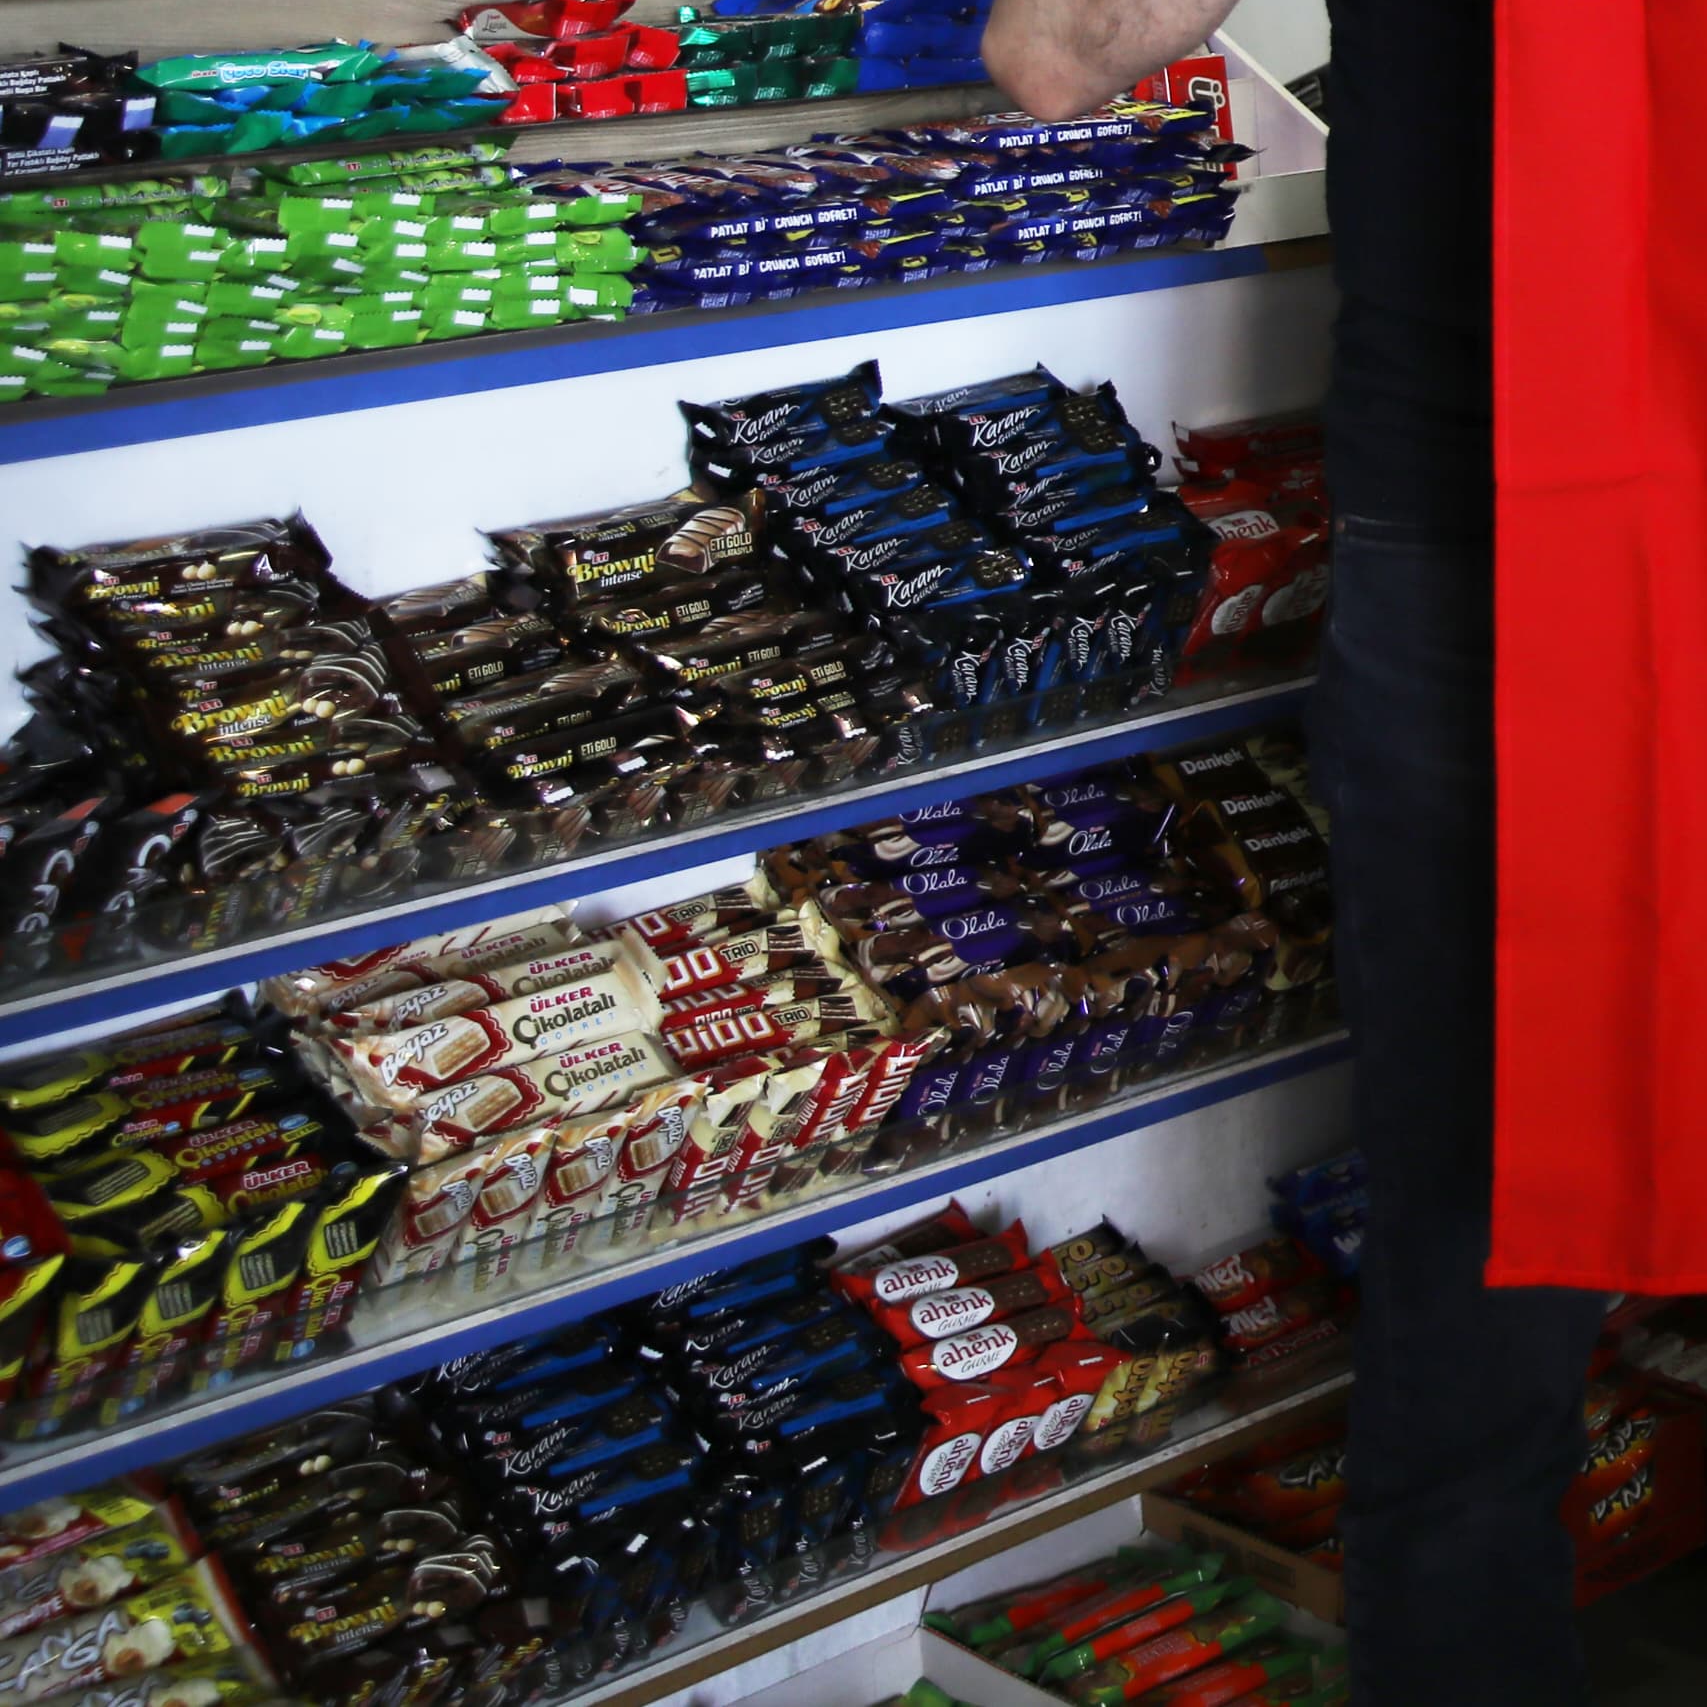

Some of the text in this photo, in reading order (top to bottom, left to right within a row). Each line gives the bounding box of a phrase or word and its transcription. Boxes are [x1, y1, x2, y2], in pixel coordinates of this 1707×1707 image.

[998, 123, 1132, 149] PATLAT CRUNCH GOFRET!
[974, 172, 1065, 196] PATLAT CRUNCH
[710, 208, 858, 239] PATLAT CRUNCH GOFRET!
[1018, 210, 1143, 240] PATLAT CRUNCH GOFRET!
[759, 255, 801, 273] CRUNCH
[804, 250, 847, 268] GOFRET!
[731, 404, 800, 445] Karam
[970, 404, 1042, 446] Karam
[785, 474, 840, 507] Karam
[727, 532, 754, 550] GOLD
[811, 508, 874, 547] Karam
[567, 547, 657, 584] Browni
[844, 536, 908, 573] Karam
[600, 569, 644, 588] intense
[887, 564, 953, 607] Karam
[692, 599, 711, 615] GOLD
[610, 610, 671, 636] Browni
[761, 645, 781, 662] GOLD
[680, 655, 743, 683] Browni
[750, 674, 808, 700] Browni
[170, 689, 290, 736] Browni
[219, 713, 273, 735] intense
[595, 736, 617, 753] GOLD
[507, 749, 574, 781] Browni
[1180, 748, 1245, 776] Dankek
[237, 772, 311, 798] Browni
[1222, 790, 1287, 817] Dankek
[1068, 829, 1112, 857] O'lala
[1245, 826, 1313, 853] Dankek
[903, 869, 968, 896] O'lala
[670, 900, 705, 923] TRIO
[942, 909, 1008, 940] O'lala
[530, 950, 594, 977] ÜLKER
[721, 940, 760, 964] TRIO
[531, 985, 593, 1014] ÜLKER
[512, 994, 618, 1047] Çikolatalı
[538, 1013, 618, 1048] GOFRET
[777, 1006, 812, 1027] TRIO
[380, 1021, 449, 1087] Beyaz
[560, 1041, 625, 1070] ÜLKER
[543, 1047, 649, 1098] Çikolatalı
[243, 1161, 311, 1191] ÜLKER
[882, 1258, 958, 1293] ahenk
[918, 1295, 993, 1324] ahenk
[939, 1328, 1016, 1368] ahenk
[709, 1343, 780, 1388] Karam
[503, 1424, 578, 1477] Karam
[288, 1597, 400, 1644] Browni
[335, 1620, 385, 1644] intense
